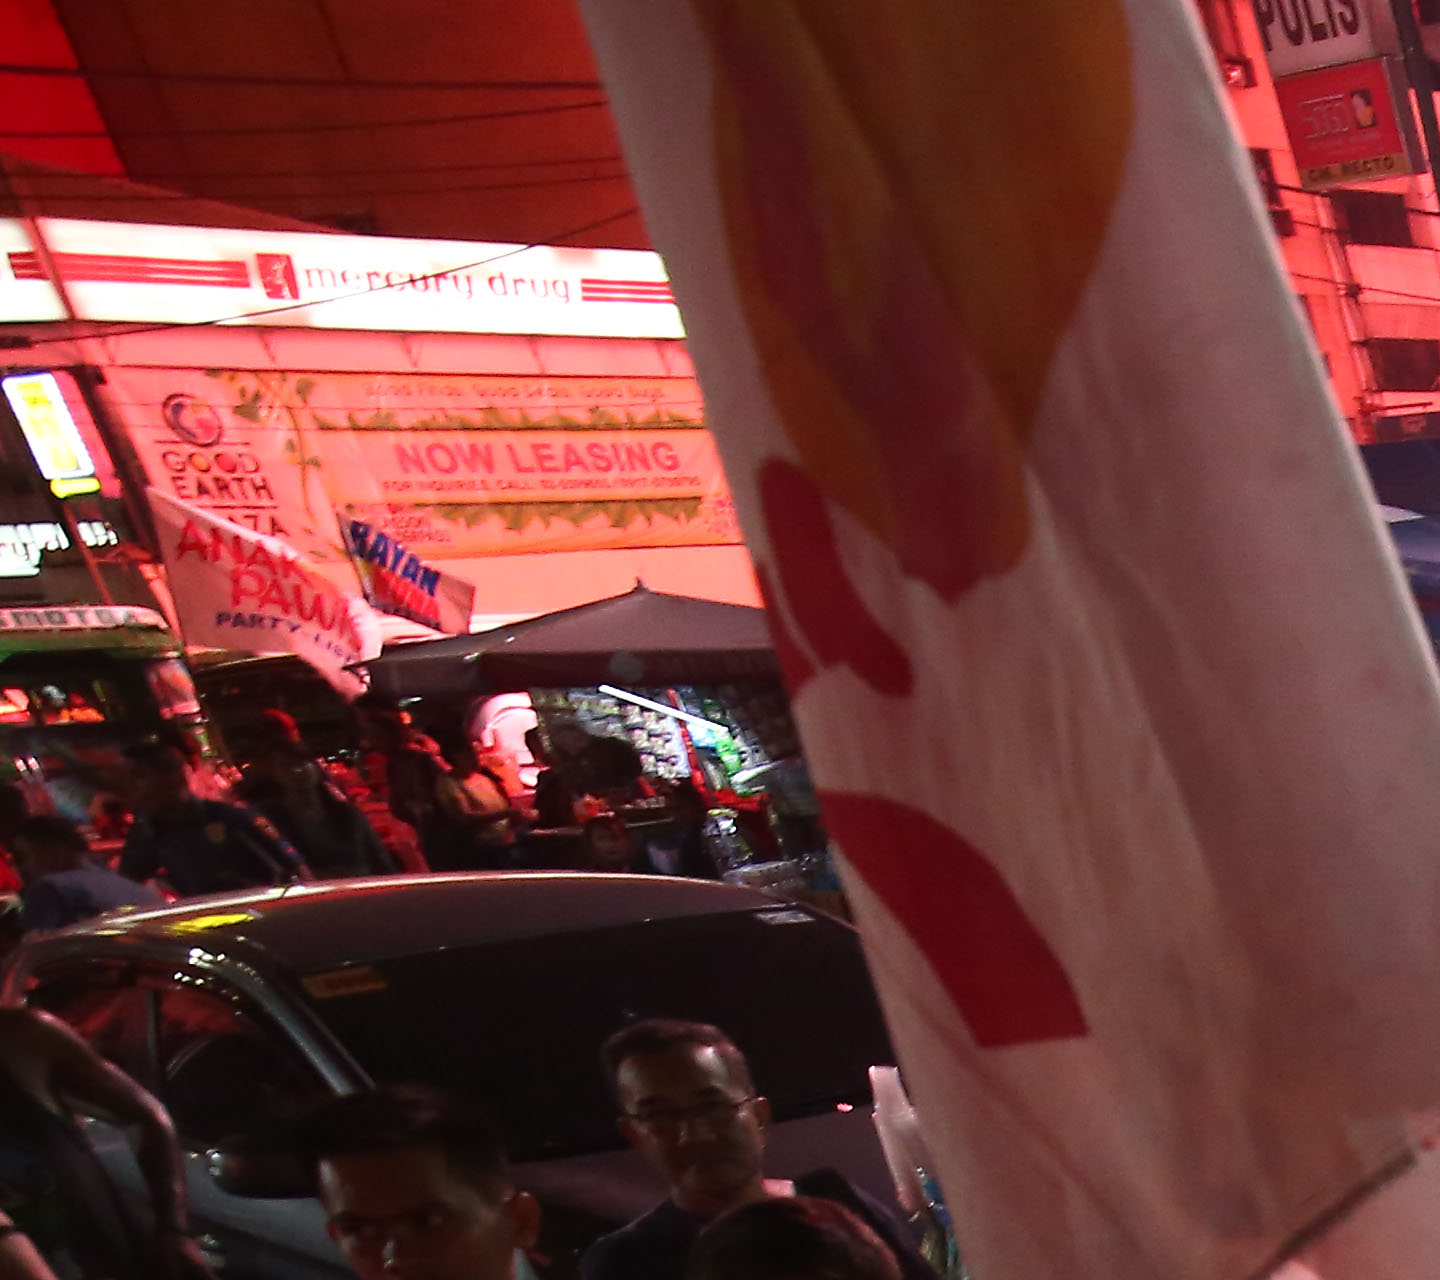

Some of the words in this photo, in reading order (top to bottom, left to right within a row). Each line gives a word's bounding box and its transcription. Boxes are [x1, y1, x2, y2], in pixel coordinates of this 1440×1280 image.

[304, 266, 474, 299] mercury
[488, 270, 570, 304] drug
[161, 451, 260, 473] GOOD
[398, 442, 496, 475] NOW
[506, 441, 681, 475] LEASING
[171, 476, 274, 500] EARTH
[350, 519, 441, 596] BAYAN
[215, 611, 301, 633] PARTY
